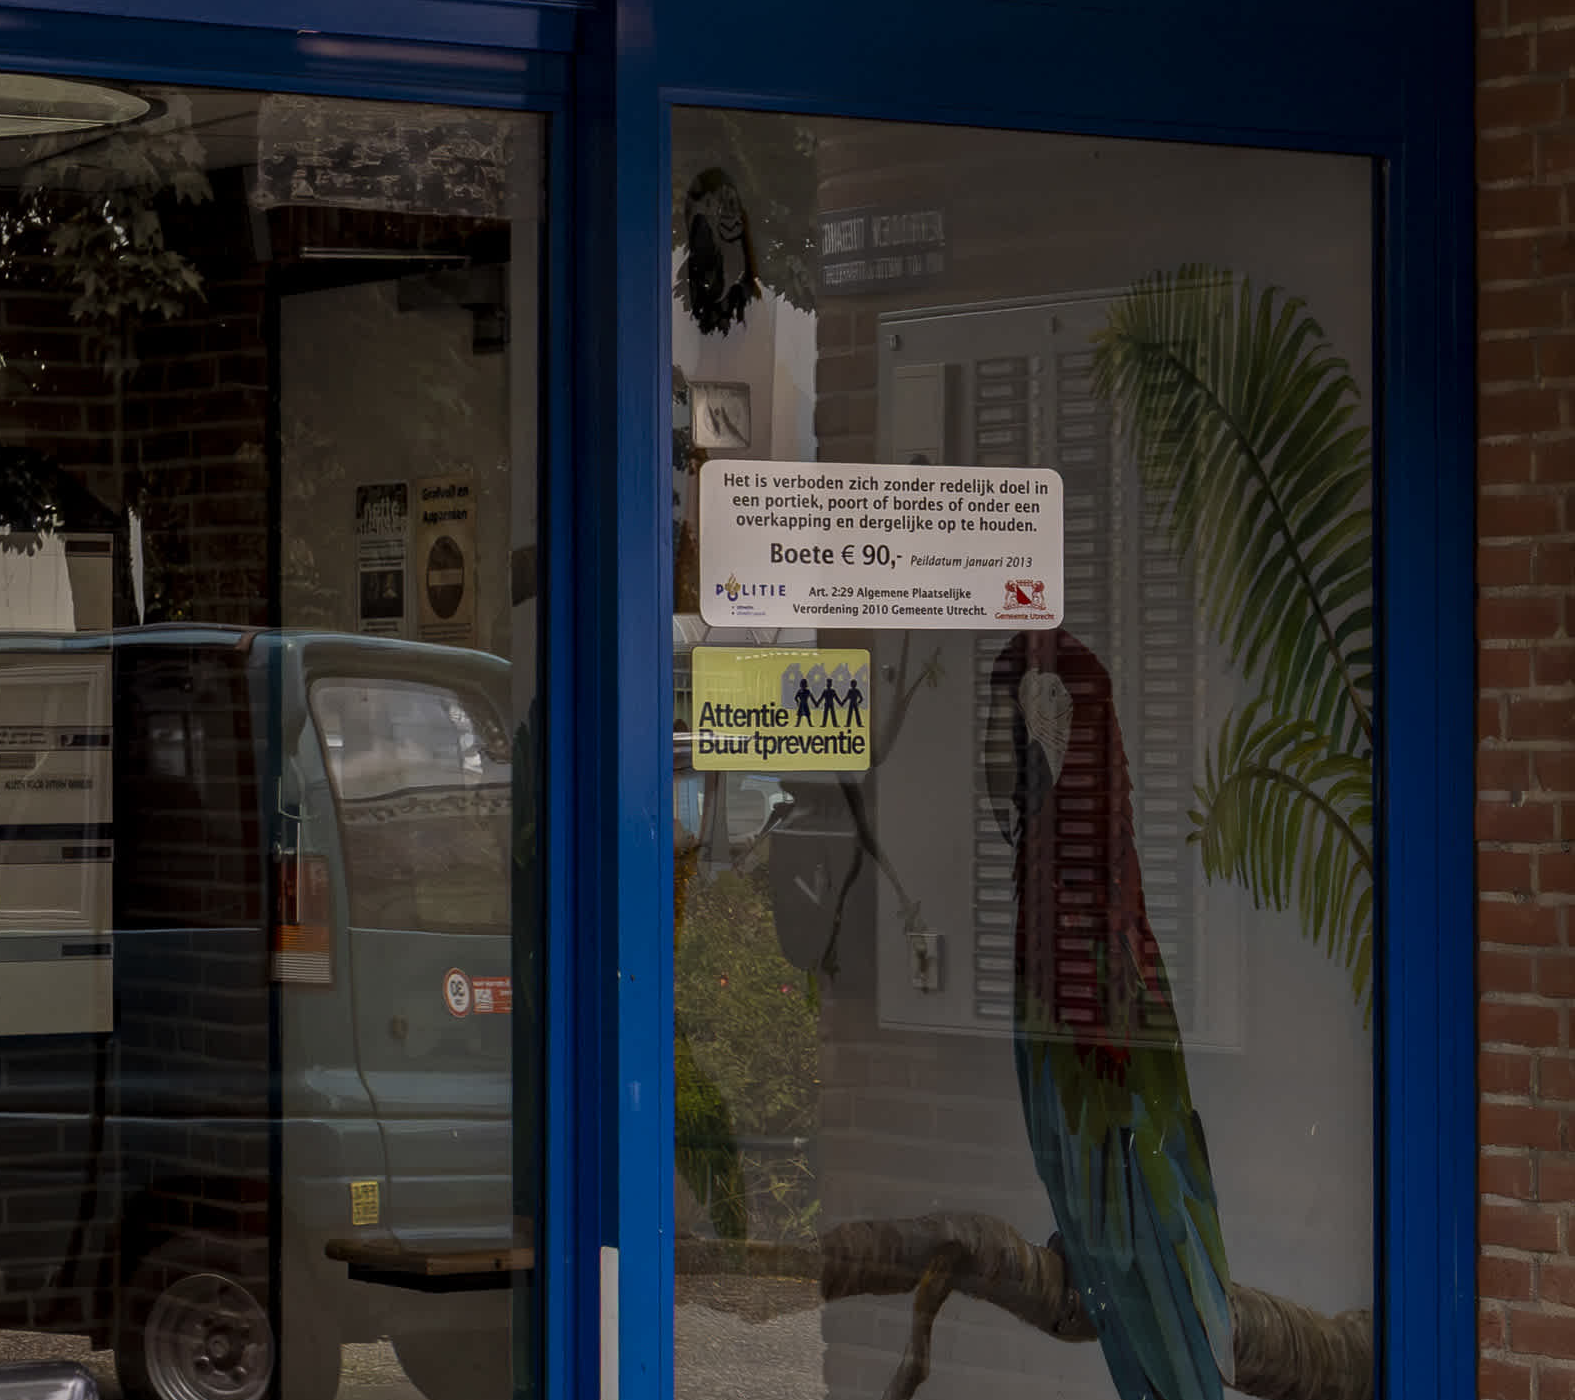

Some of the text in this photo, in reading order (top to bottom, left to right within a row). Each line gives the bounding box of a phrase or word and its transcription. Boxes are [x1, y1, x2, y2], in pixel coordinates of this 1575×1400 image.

[723, 473, 1048, 496] Het is verboden zich zonder redelijk doel in
[732, 494, 1040, 513] een portiek, poort of bordes of onder een
[736, 513, 1038, 534] overkapping en dergelijke op te houden.
[770, 543, 834, 564] Boete
[841, 544, 856, 565] €
[910, 555, 962, 568] Peildatum
[964, 556, 1003, 568] januari
[1006, 556, 1033, 568] 2013
[809, 587, 971, 601] Art. 2:29 Algemene Plaatselijke
[793, 603, 988, 616] Verordening 2010 Gemeente Utrecht.
[699, 701, 789, 728] Attentie
[698, 728, 865, 760] Buurtpreventie
